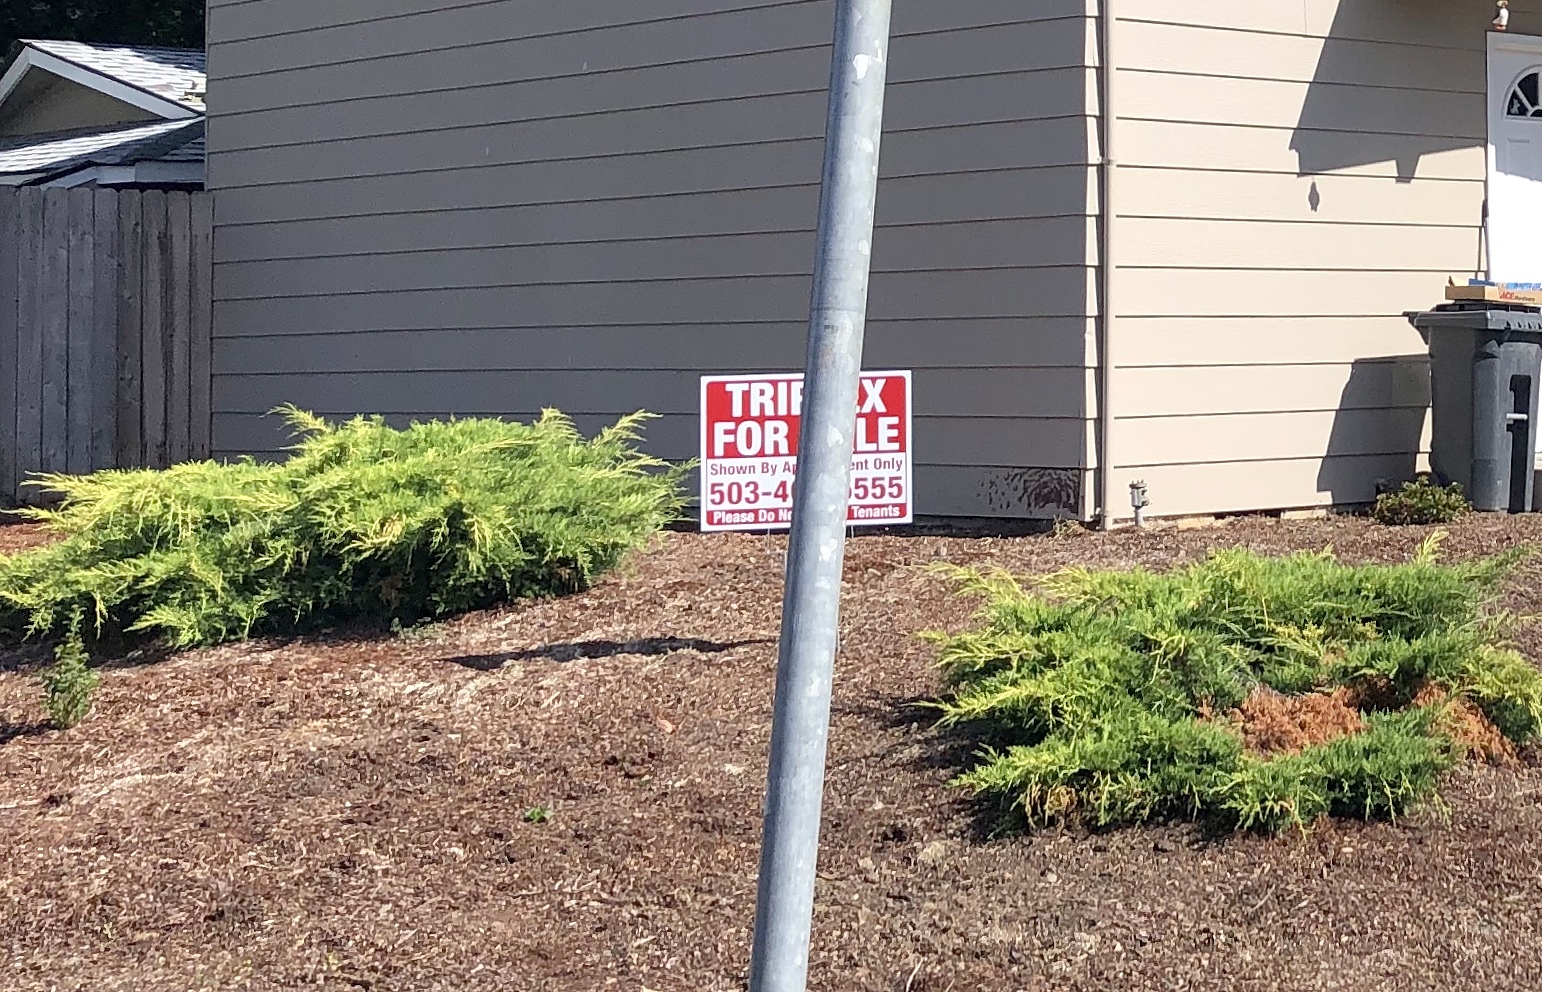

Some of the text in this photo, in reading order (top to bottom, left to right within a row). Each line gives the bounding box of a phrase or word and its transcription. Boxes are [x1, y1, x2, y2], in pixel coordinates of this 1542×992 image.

[725, 378, 888, 418] TRIX
[713, 420, 790, 457] FOR
[710, 462, 756, 476] Shown
[761, 461, 778, 476] By
[873, 457, 903, 471] Only
[713, 509, 755, 524] Please
[758, 509, 776, 522] Do
[852, 504, 901, 520] Tenants
